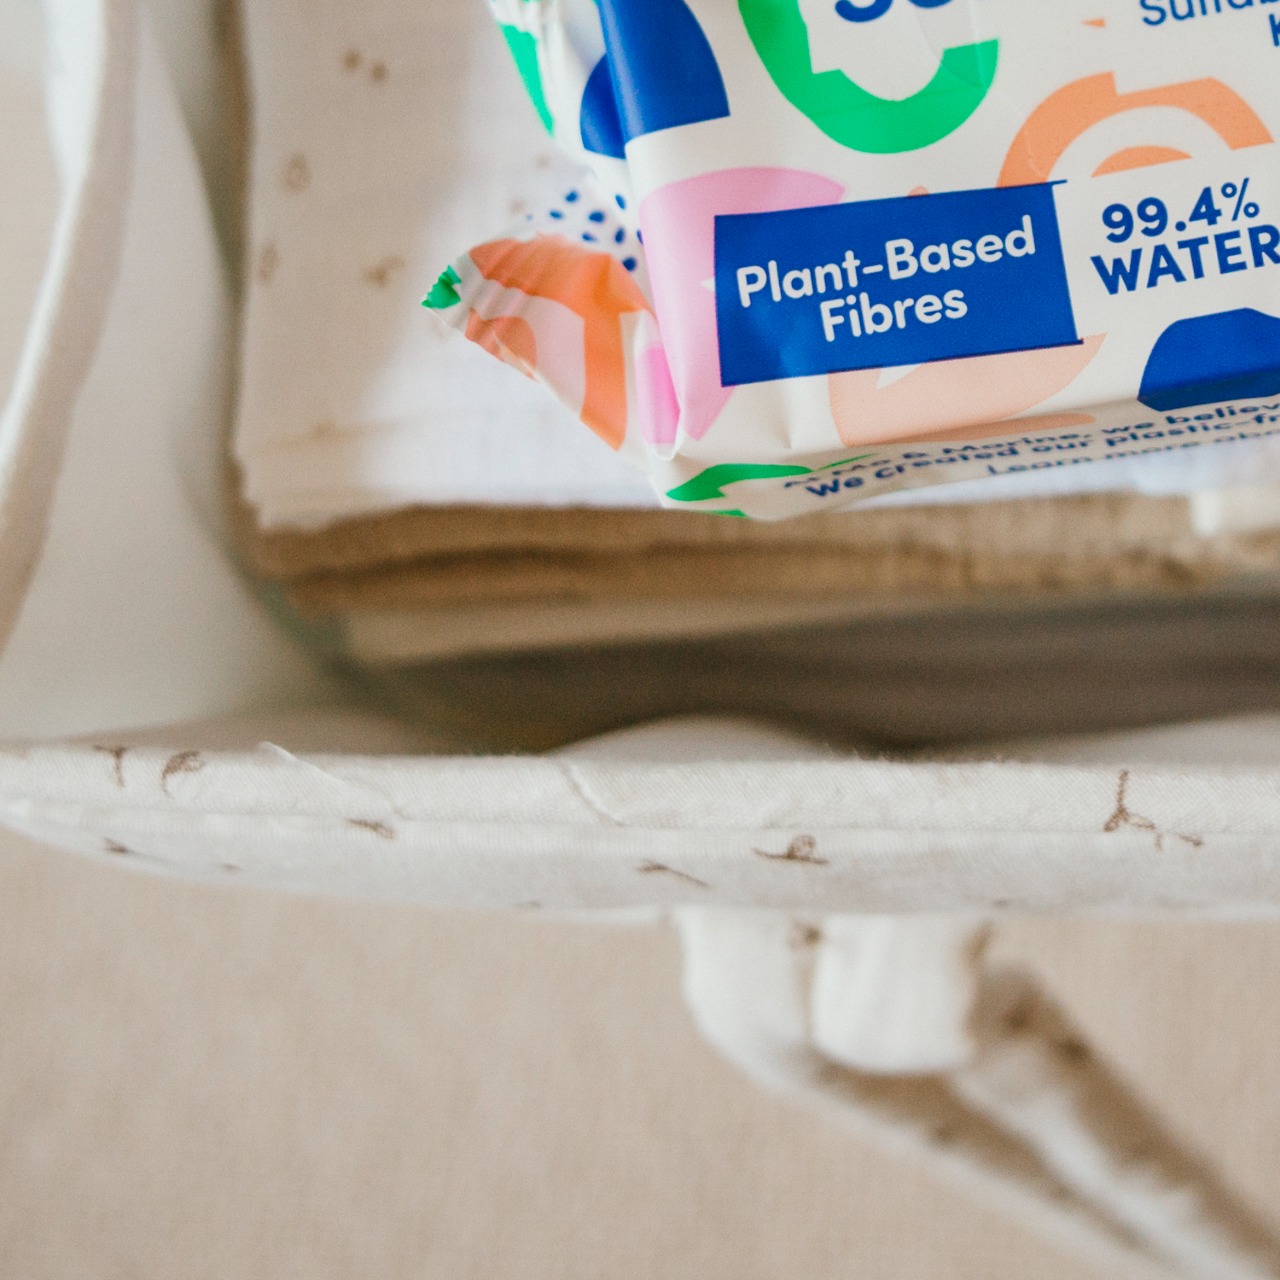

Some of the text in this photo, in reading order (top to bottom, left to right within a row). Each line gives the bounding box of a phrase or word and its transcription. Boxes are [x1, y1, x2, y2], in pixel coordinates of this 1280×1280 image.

[1100, 176, 1260, 244] 99.4%
[736, 214, 1037, 308] Plant-Based
[818, 288, 969, 343] Fibres
[1101, 422, 1155, 434] we
[806, 477, 865, 498] We
[874, 446, 1020, 479] created
[1031, 439, 1093, 452] our
